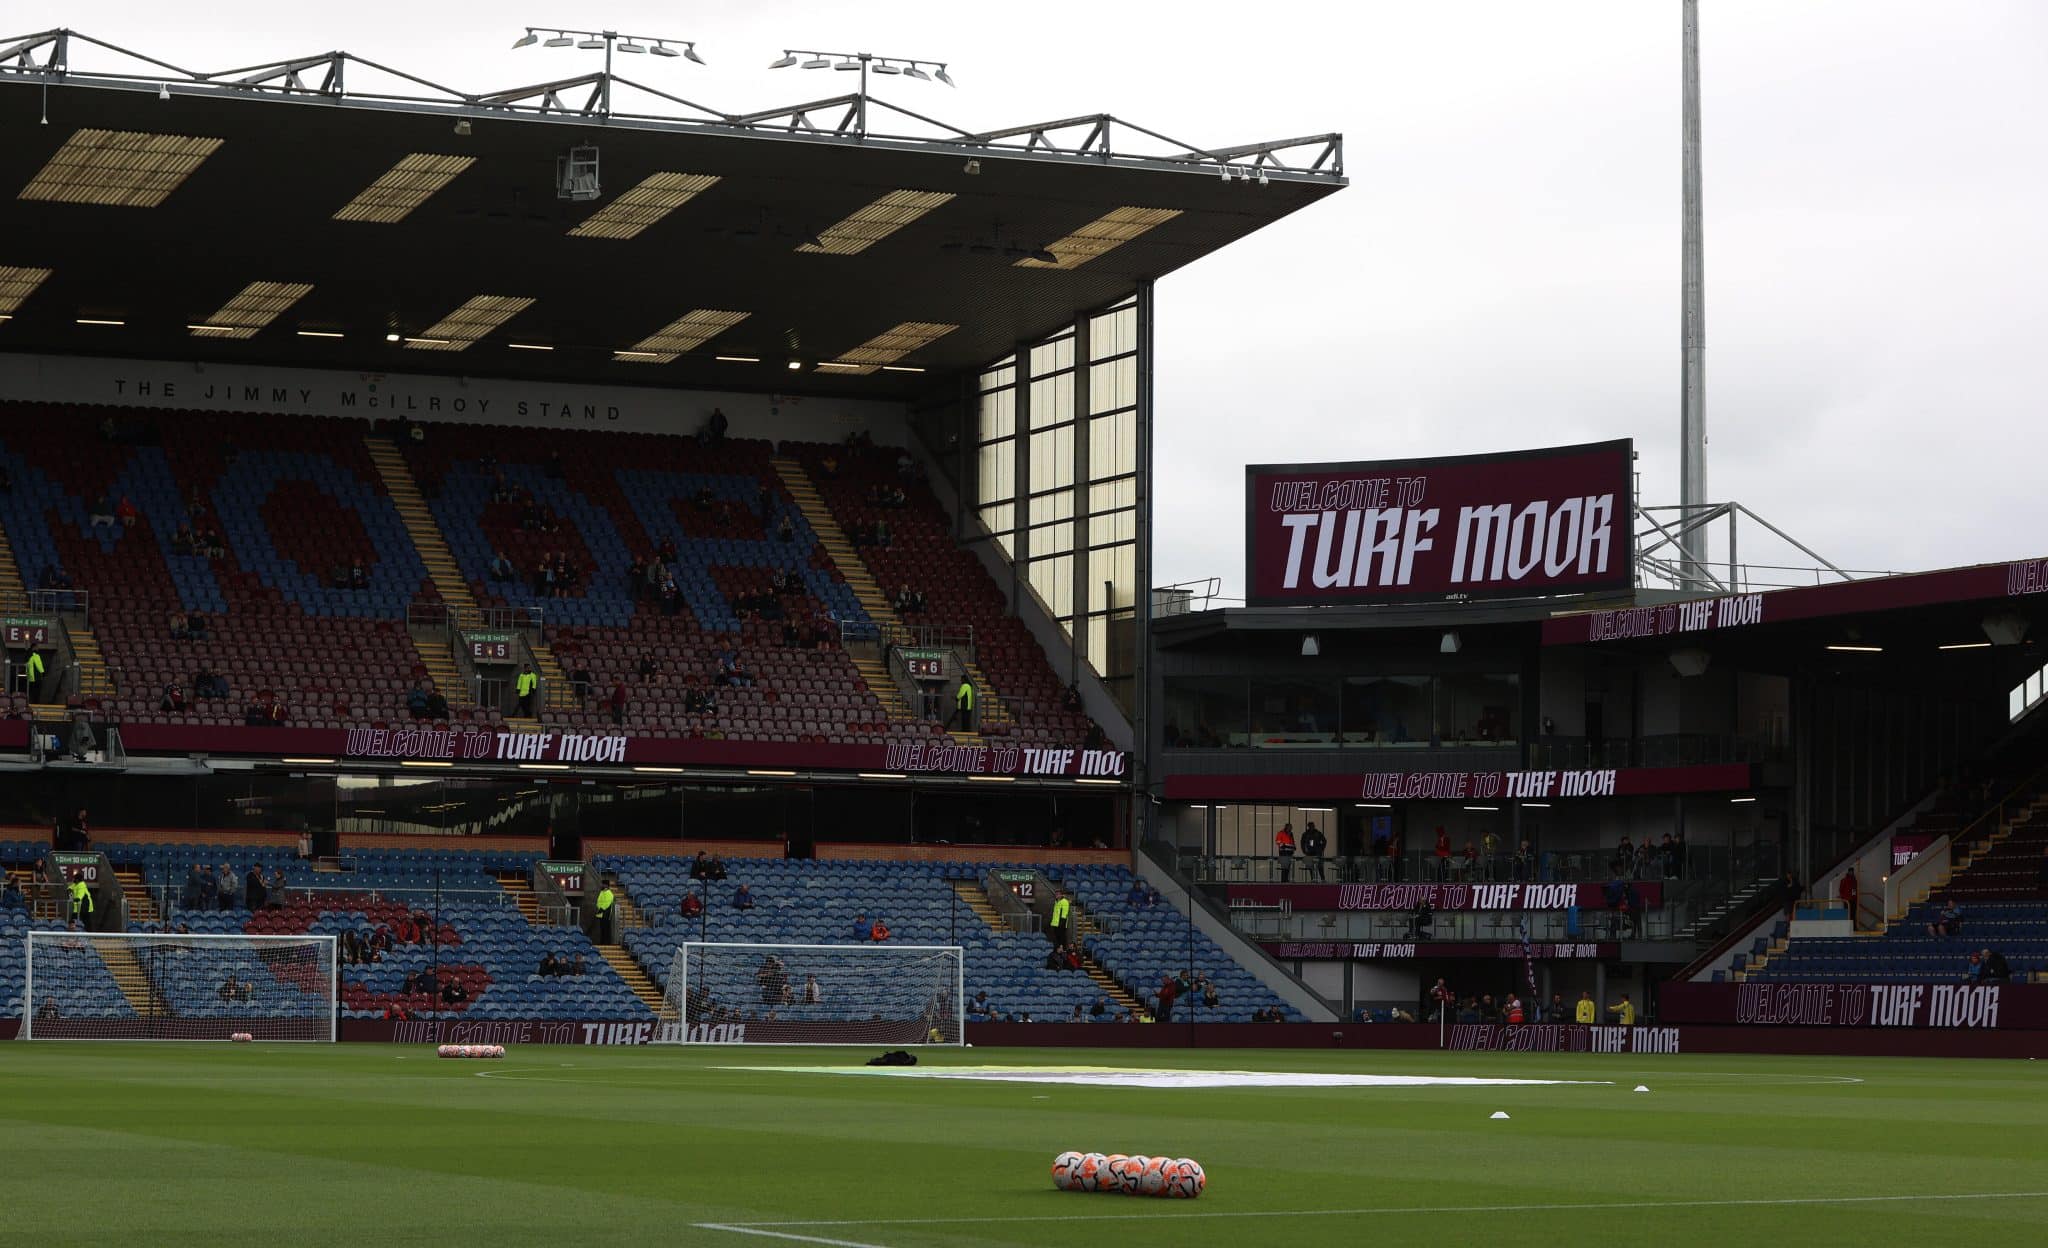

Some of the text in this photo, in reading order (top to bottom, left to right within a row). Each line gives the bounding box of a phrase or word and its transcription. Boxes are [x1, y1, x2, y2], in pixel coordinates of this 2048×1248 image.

[115, 380, 175, 397] THE
[205, 384, 311, 404] JIMMY
[518, 401, 619, 421] STAND
[1270, 476, 1426, 512] WELCOME TO
[1281, 493, 1615, 589] TURF MOOR
[1589, 594, 1763, 642] WELCOME TO TURF MOOR
[10, 628, 44, 641] E 4
[474, 643, 505, 656] E 5
[908, 660, 938, 673] E 6
[345, 728, 627, 763] WELCOME TO TURF MOOR
[885, 744, 988, 773] WELCOME
[992, 747, 1020, 774] TO
[1023, 748, 1075, 775] TURF
[1362, 769, 1617, 799] WELCOME TO TURF MOOR
[81, 866, 97, 880] 10
[568, 875, 580, 889] 11
[1019, 883, 1033, 896] 12
[1442, 884, 1468, 910] TO
[1471, 883, 1521, 910] TURF
[1523, 883, 1577, 909] MOOR
[1353, 943, 1381, 958] TURF
[1382, 943, 1416, 958] MOOR
[1555, 944, 1576, 958] TURF
[1576, 944, 1597, 958] MOOR
[1736, 984, 2000, 1028] WELCOME TO TURF MOOR
[582, 1022, 652, 1045] TURF
[1590, 1026, 1628, 1053] TURF
[1631, 1026, 1680, 1053] MOOR
